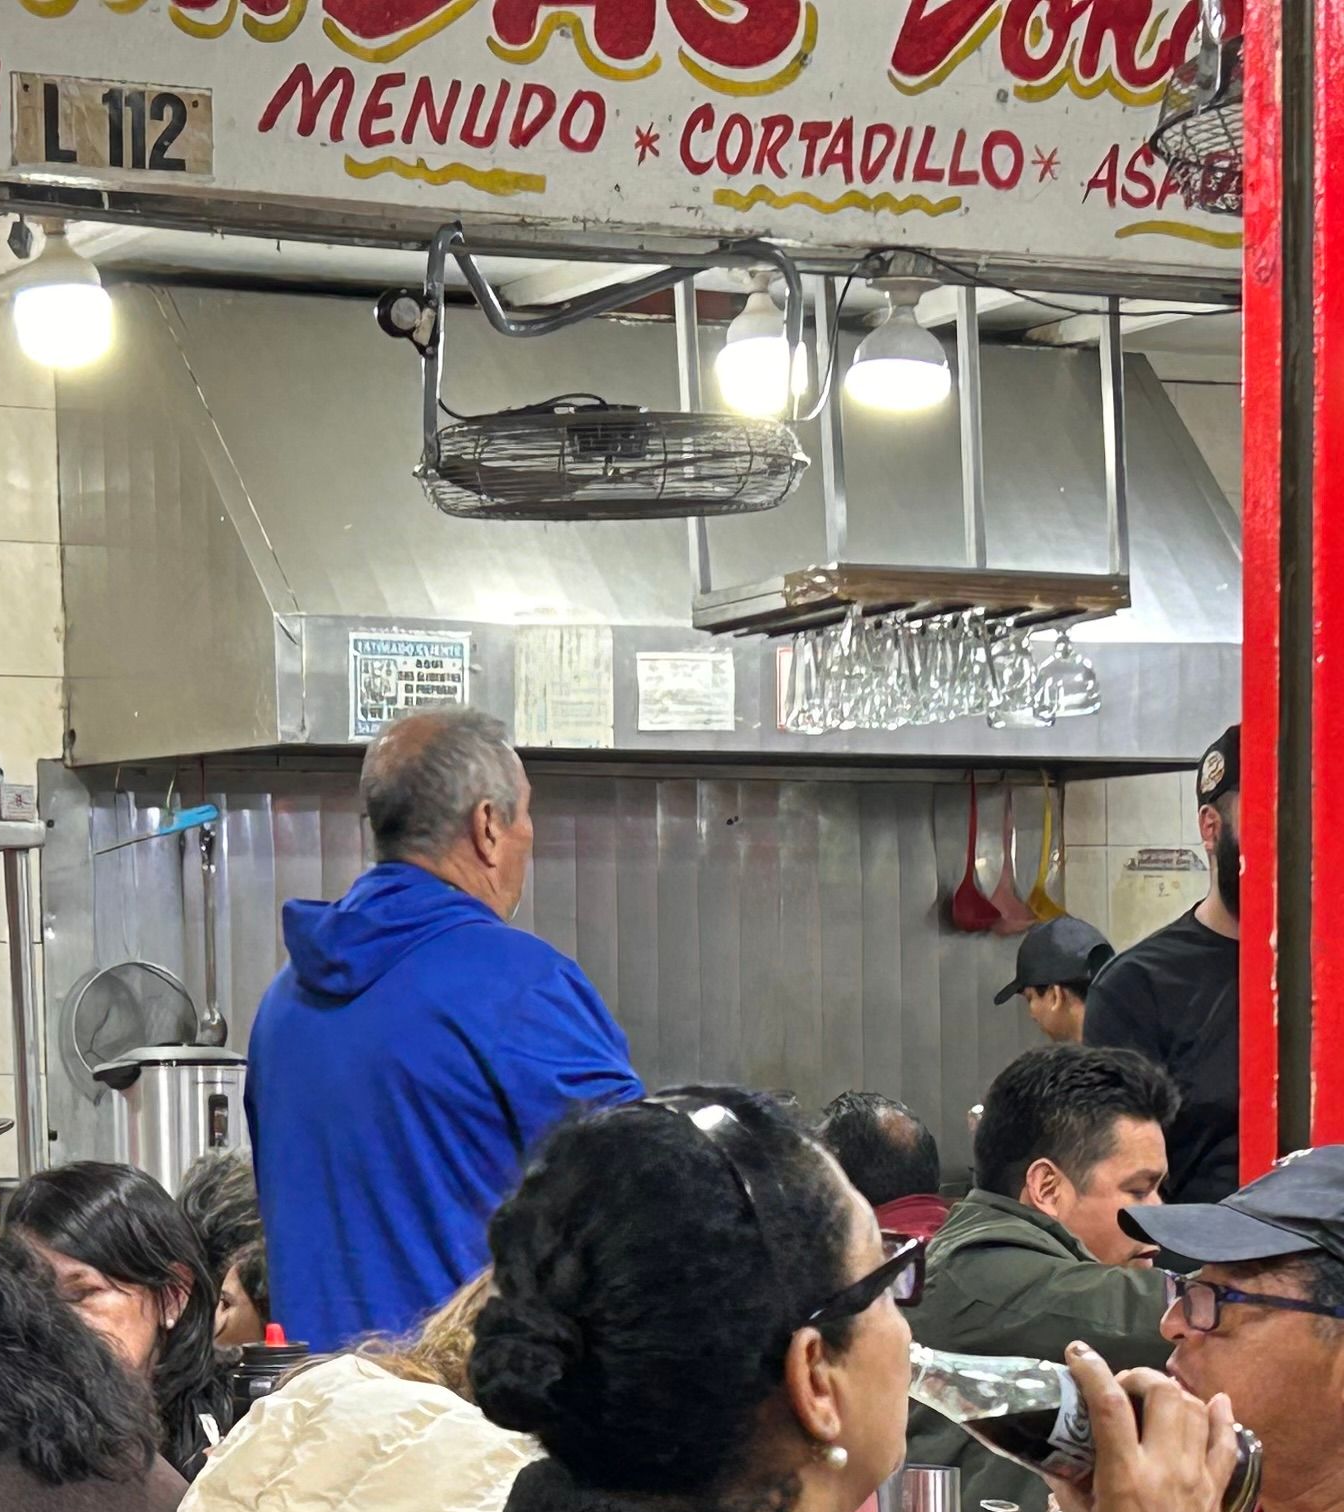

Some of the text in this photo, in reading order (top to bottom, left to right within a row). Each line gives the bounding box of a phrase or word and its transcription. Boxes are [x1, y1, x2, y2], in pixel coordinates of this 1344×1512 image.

[43, 83, 188, 171] L 112
[257, 62, 607, 154] MENUDO
[679, 102, 1026, 192] CORTADILLO
